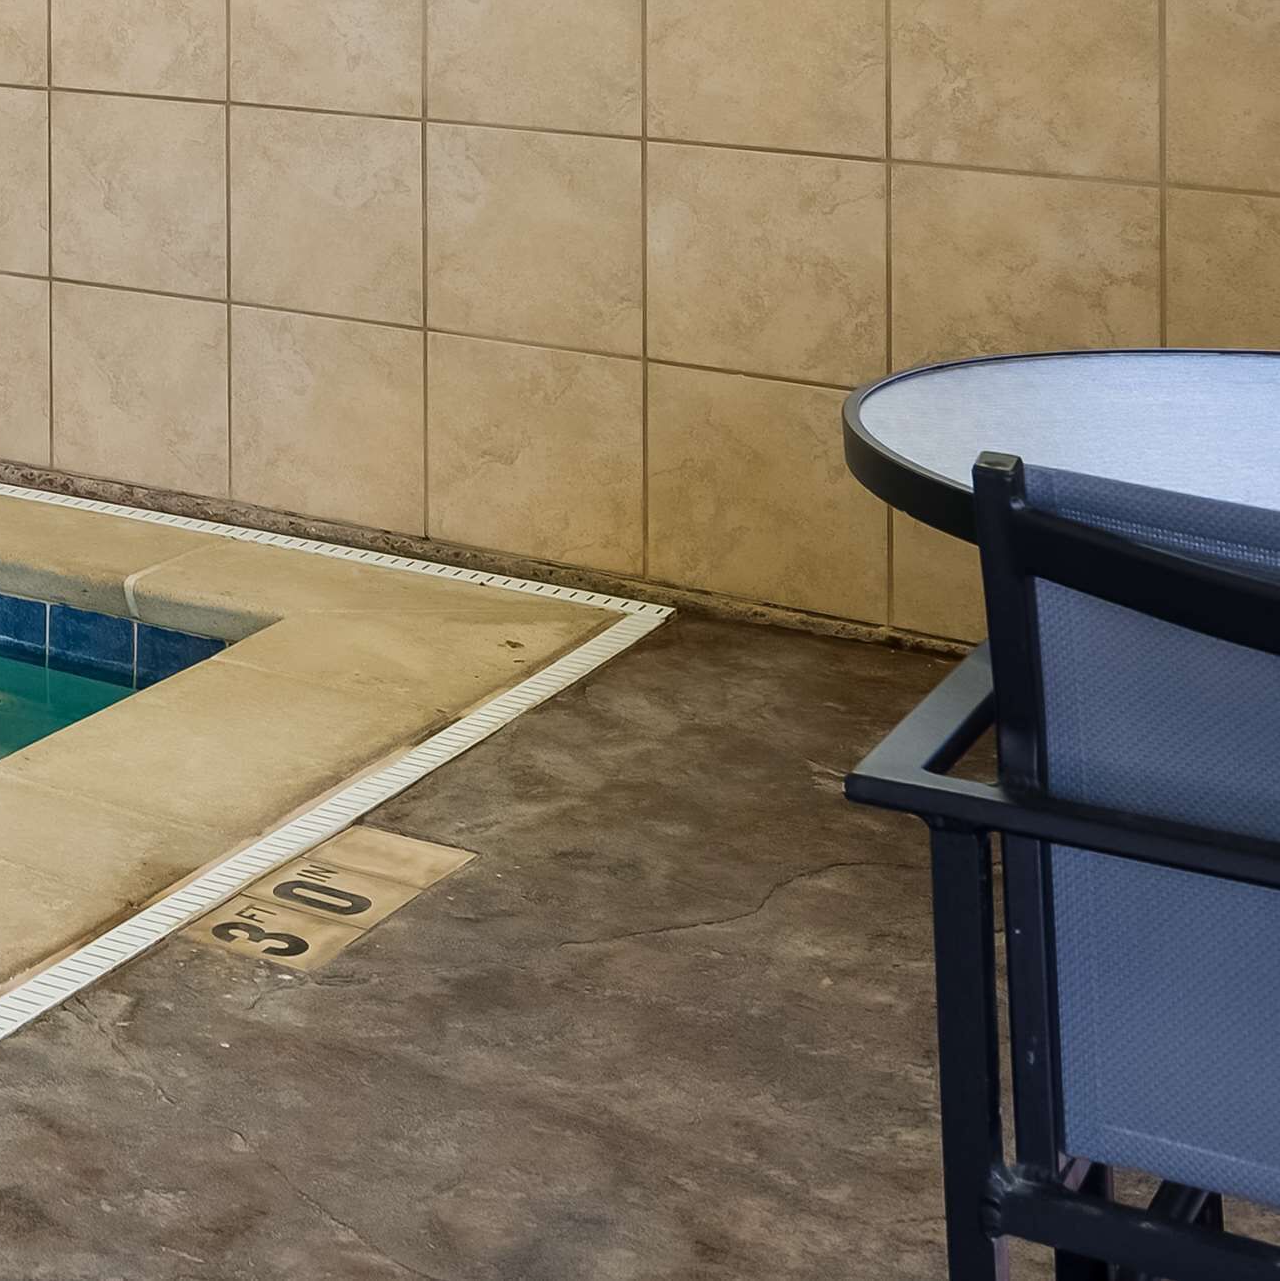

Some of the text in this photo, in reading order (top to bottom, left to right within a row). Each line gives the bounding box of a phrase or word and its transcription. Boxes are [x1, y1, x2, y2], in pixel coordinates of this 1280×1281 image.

[211, 864, 372, 957] 3 FT 0 IN
